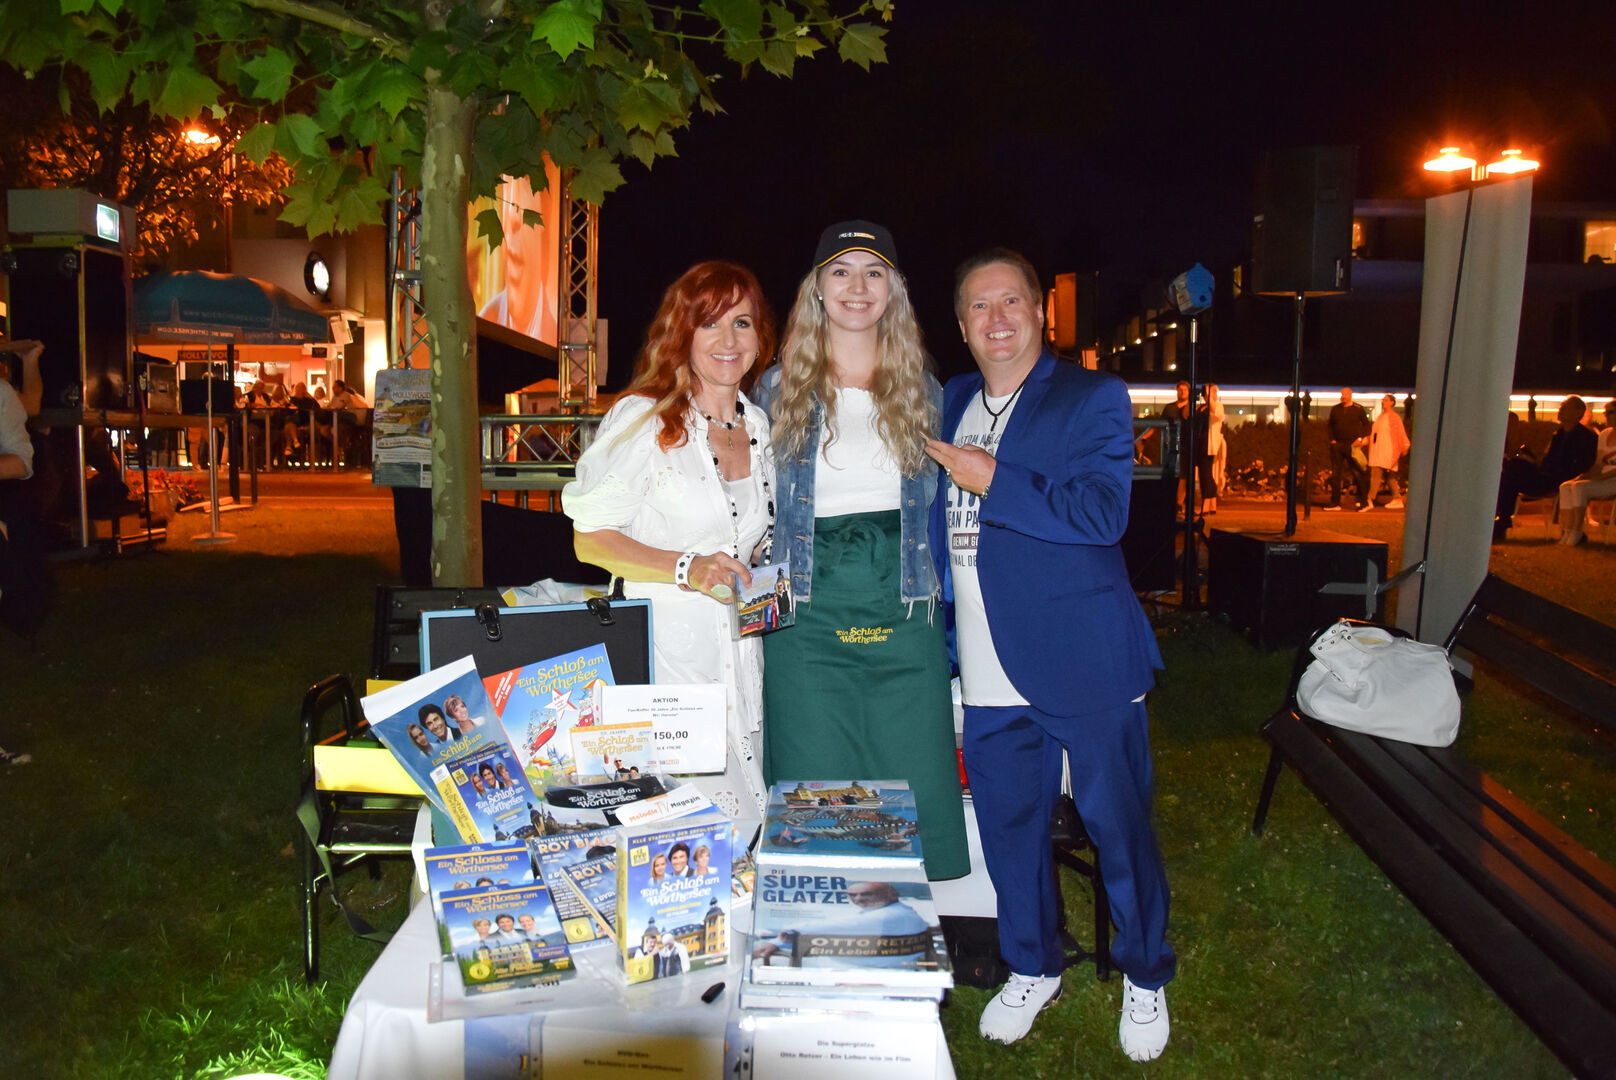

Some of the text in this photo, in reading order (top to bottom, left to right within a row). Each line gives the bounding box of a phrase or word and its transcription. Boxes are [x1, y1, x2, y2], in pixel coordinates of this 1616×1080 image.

[516, 656, 605, 688] Ein Schloß am
[654, 731, 688, 741] 150,00
[440, 735, 472, 760] Schloß
[487, 786, 515, 804] Schloß
[568, 795, 586, 803] Ein
[586, 786, 626, 799] Schloß
[670, 795, 700, 809] Magazin
[538, 834, 616, 854] ROY BLAC
[437, 861, 453, 869] Ein
[454, 854, 503, 868] Schloss
[571, 864, 603, 881] ROY
[640, 875, 720, 897] Ein Schloß am
[763, 875, 847, 890] SUPER
[471, 893, 521, 906] Schloss
[762, 889, 850, 904] GLATZE
[810, 937, 870, 947] OTTO
[809, 947, 833, 955] Ein
[838, 947, 877, 955] Leben
